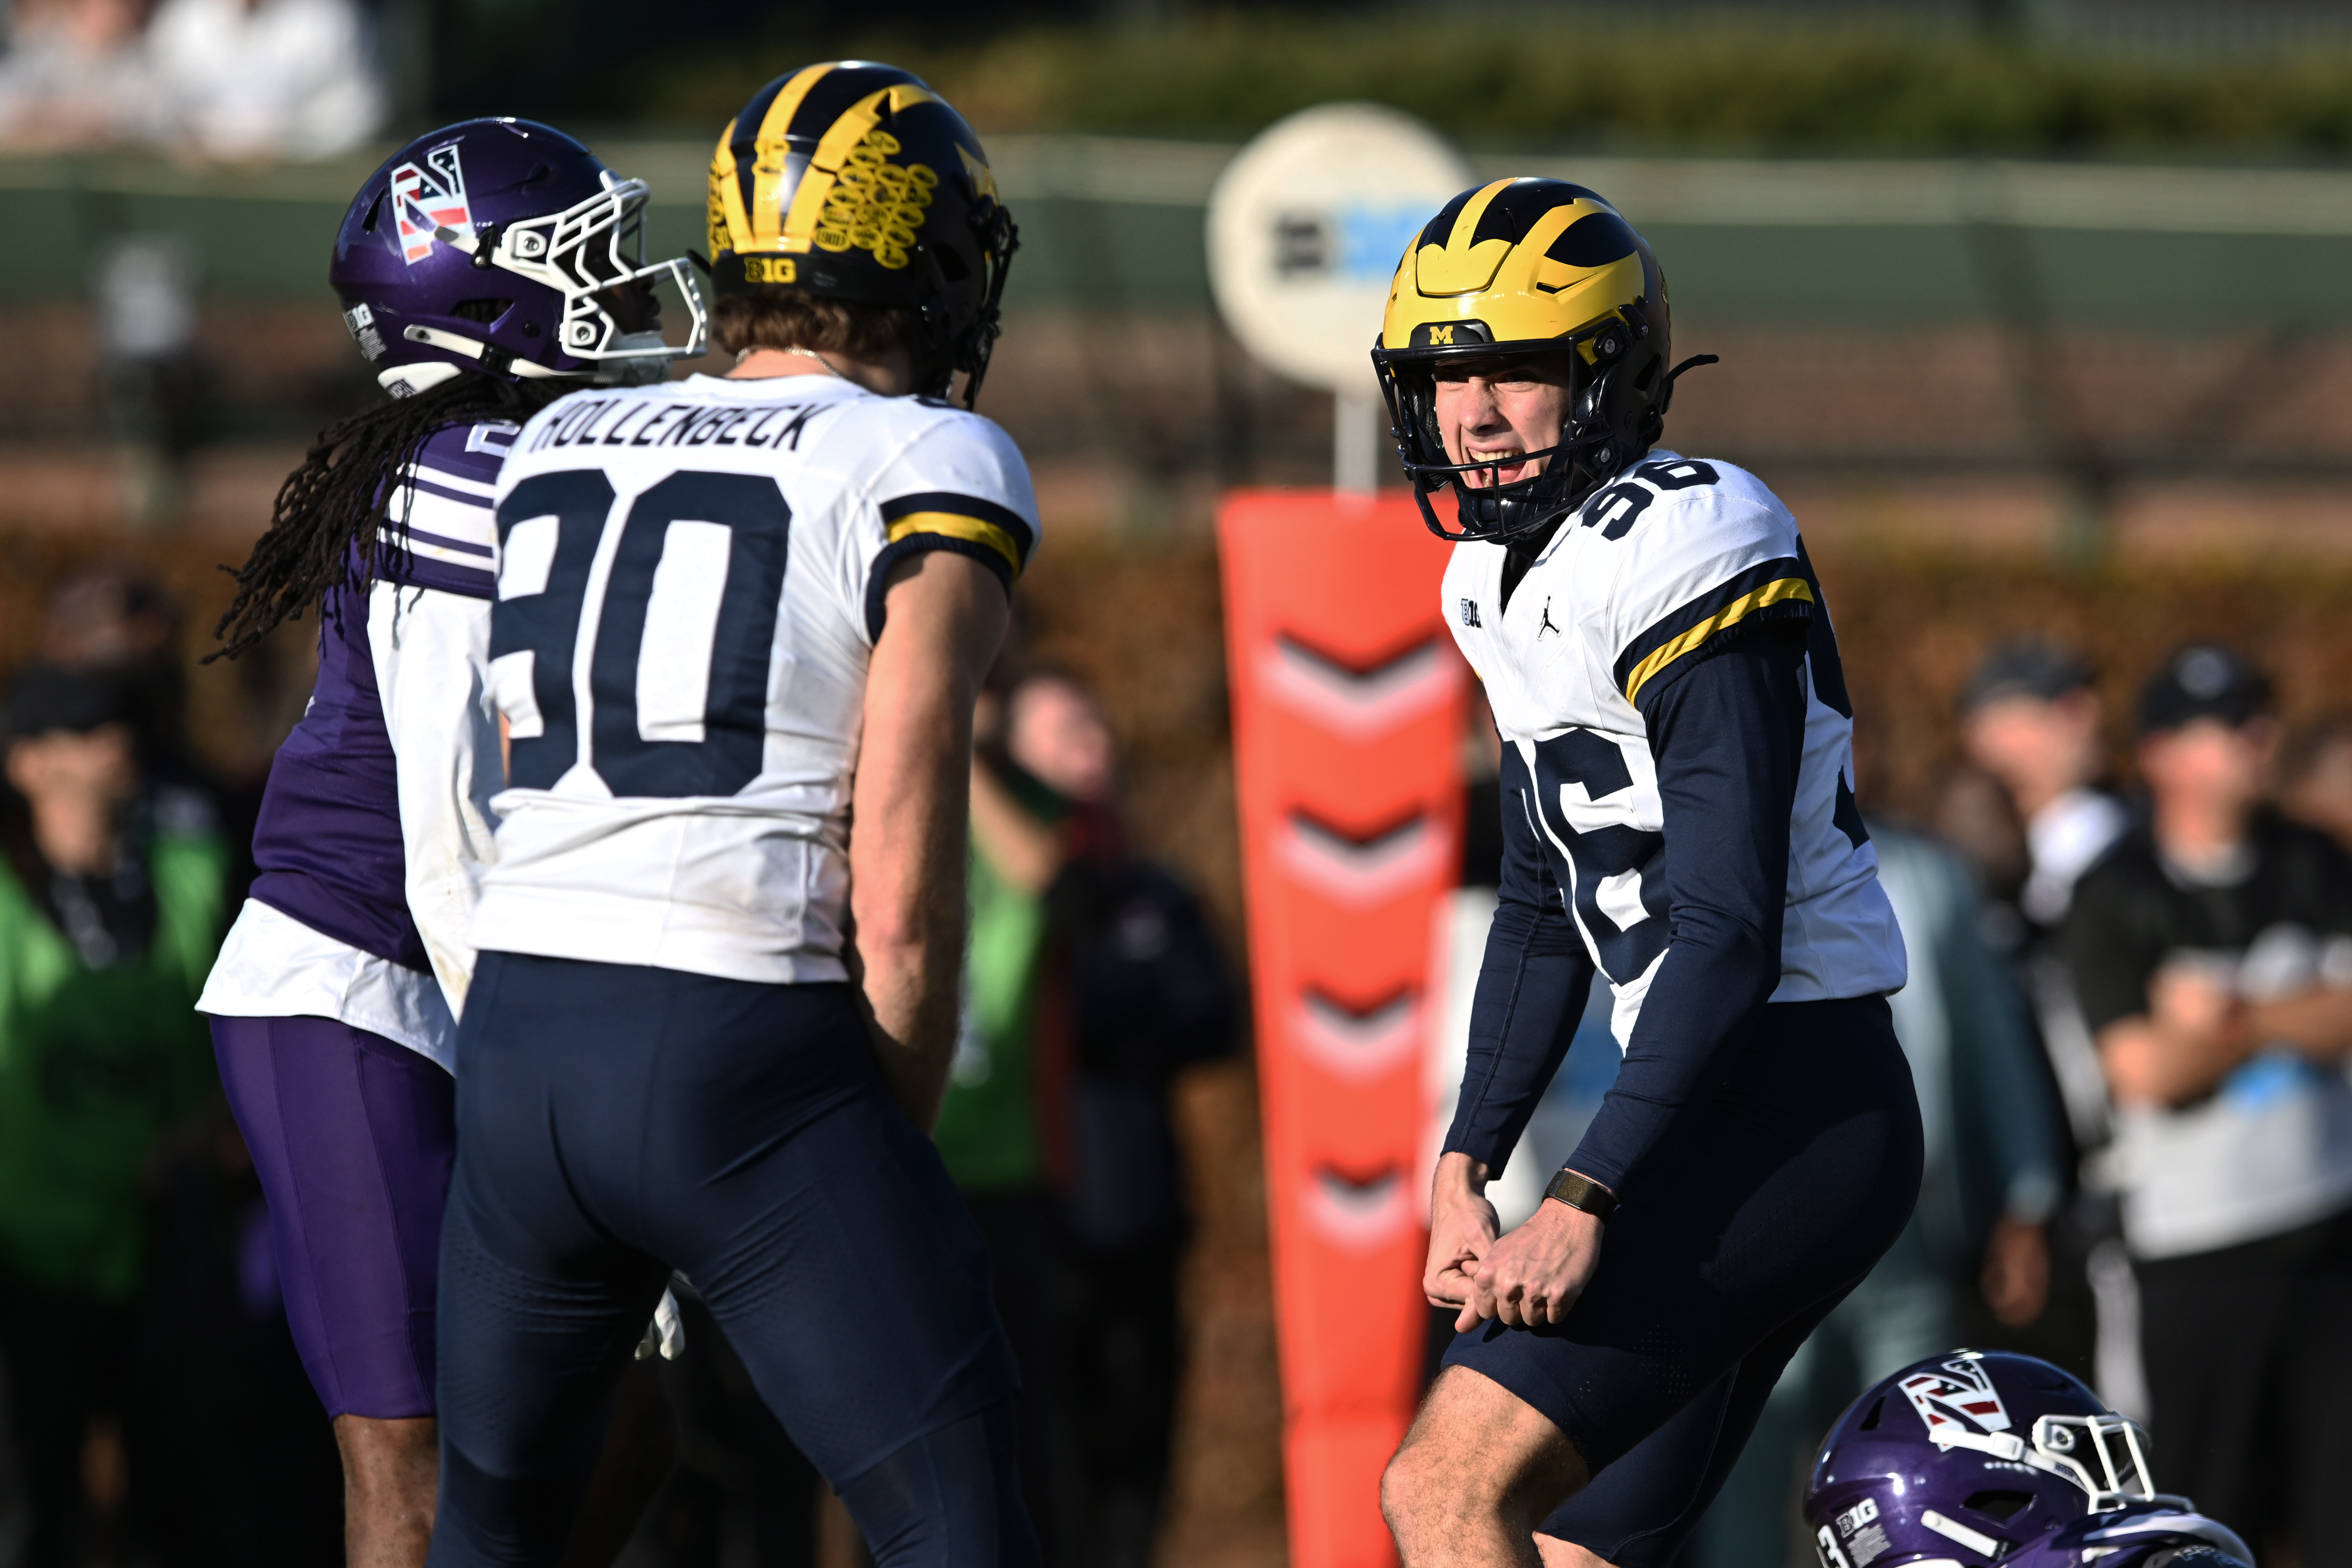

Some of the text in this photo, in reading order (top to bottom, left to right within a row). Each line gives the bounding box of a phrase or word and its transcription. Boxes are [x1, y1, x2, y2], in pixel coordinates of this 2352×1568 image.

[1430, 325, 1454, 345] M
[528, 399, 835, 453] HOLLENBECK
[1581, 460, 1720, 542] 96
